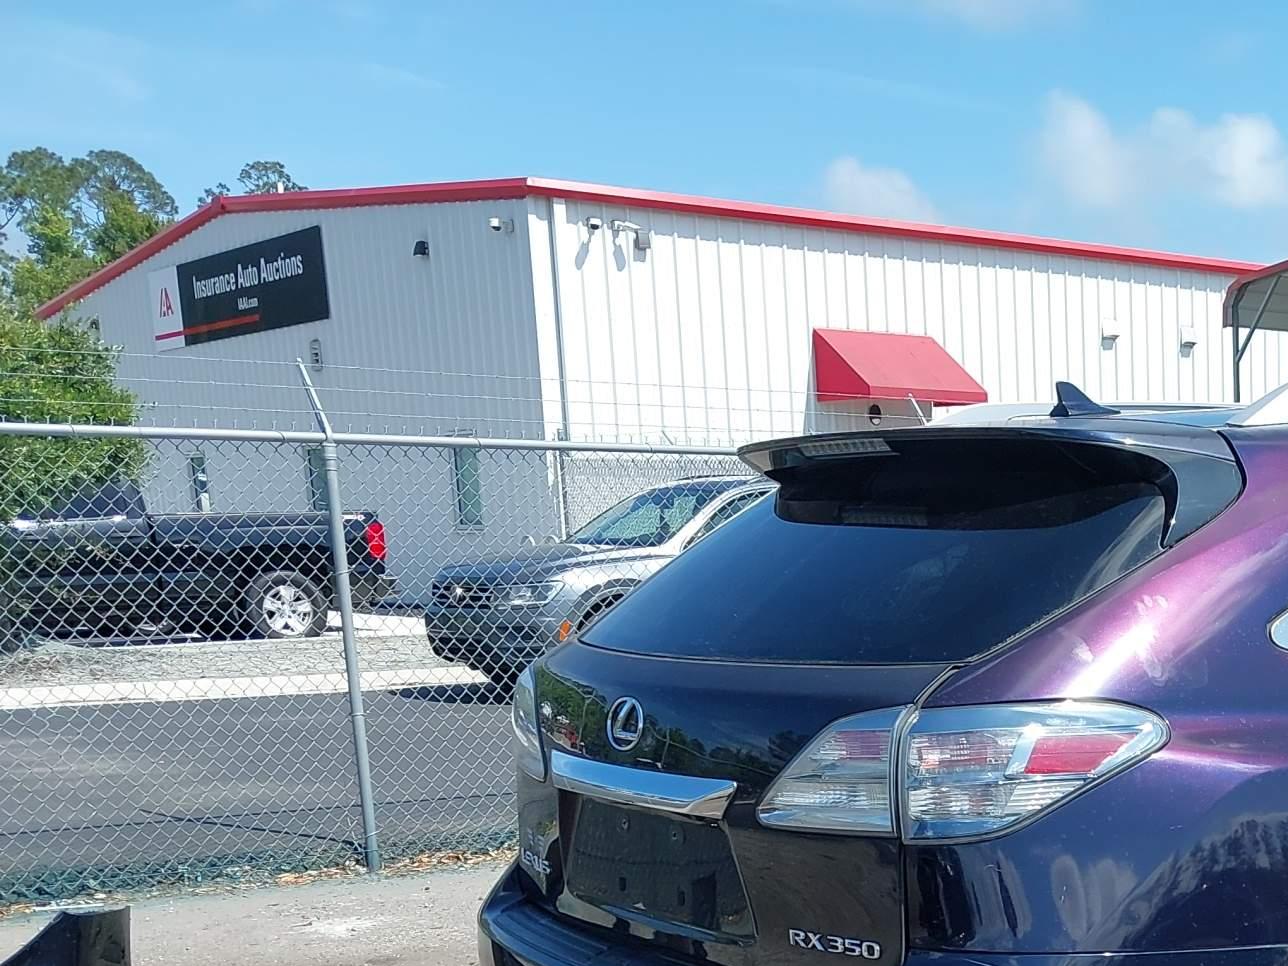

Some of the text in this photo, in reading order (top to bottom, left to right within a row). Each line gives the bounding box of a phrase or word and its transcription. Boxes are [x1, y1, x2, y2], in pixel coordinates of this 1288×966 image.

[192, 252, 304, 299] Insurance Auto Auctions
[520, 847, 551, 875] LEXUS
